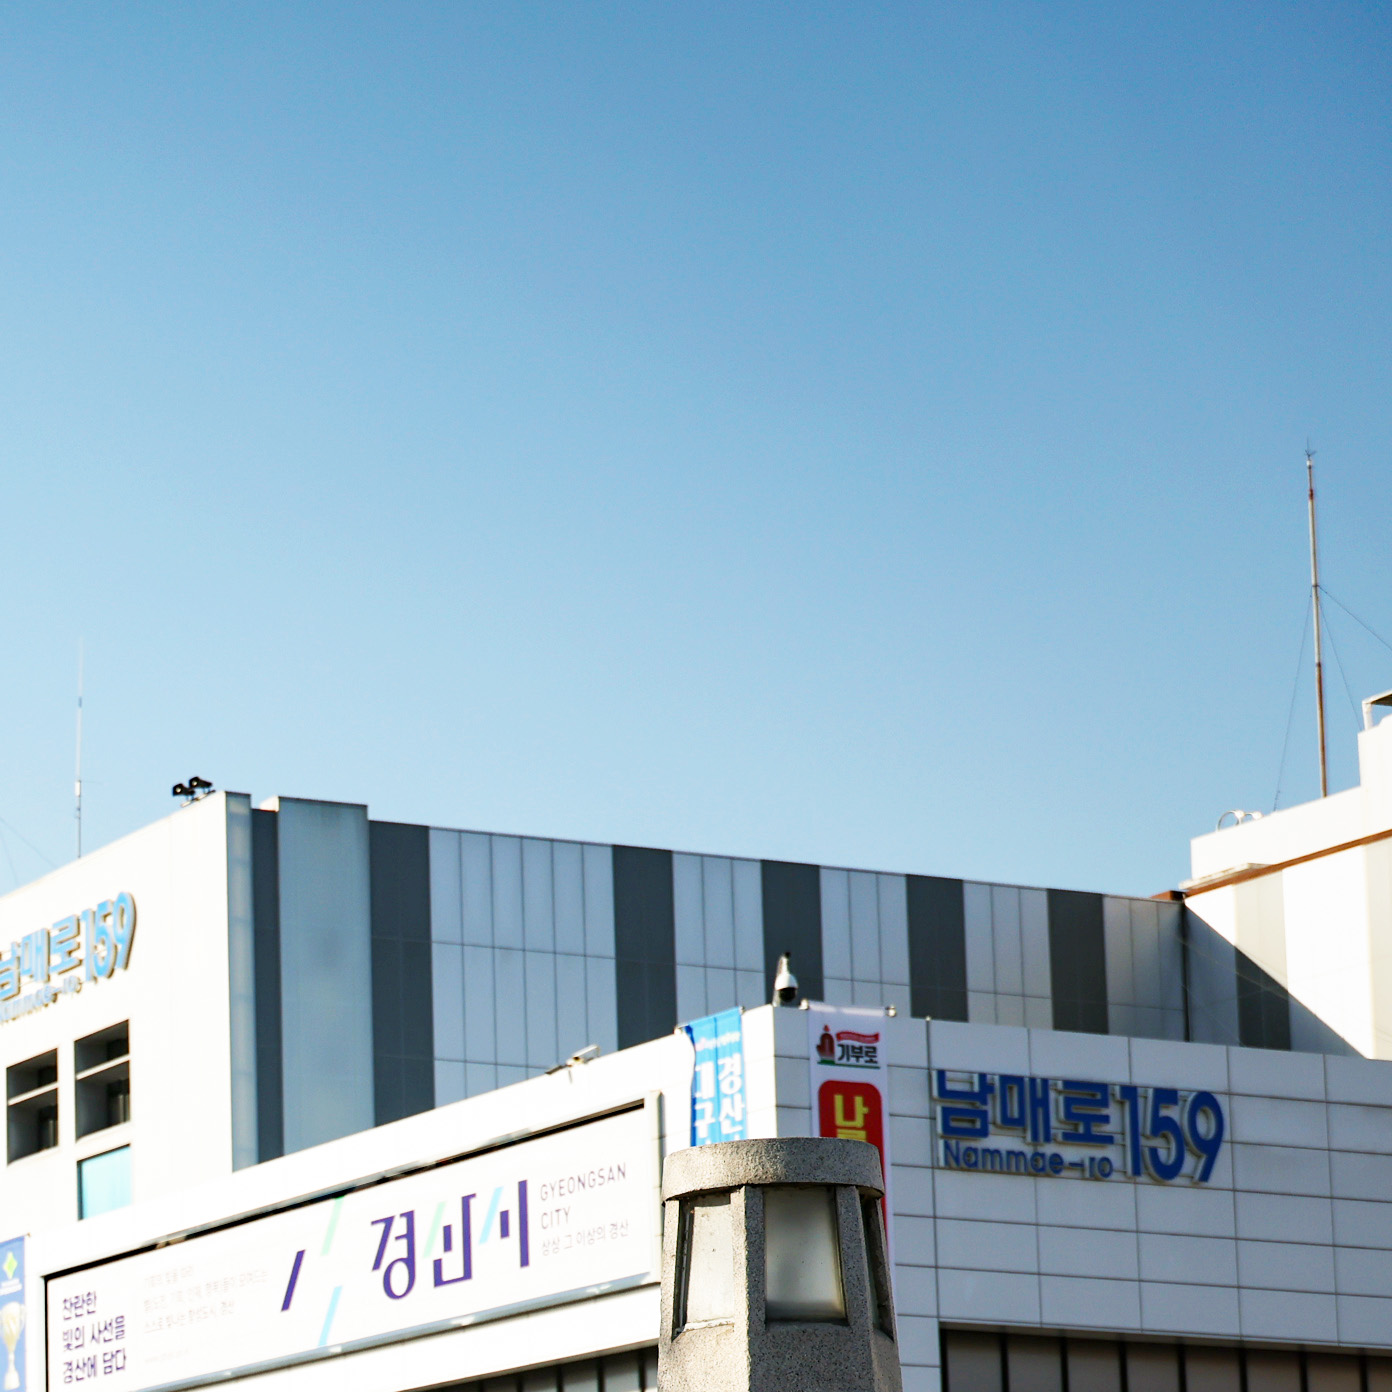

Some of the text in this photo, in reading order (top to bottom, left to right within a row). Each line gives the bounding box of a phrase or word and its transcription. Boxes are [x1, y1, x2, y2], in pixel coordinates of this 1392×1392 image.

[838, 1043, 879, 1065] 기부로
[940, 1138, 1115, 1180] Nammae-ro
[540, 1162, 628, 1201] GYEONGSAN
[540, 1206, 572, 1230] CITY
[370, 1179, 531, 1300] 경산시
[541, 1219, 630, 1257] 상상 그 이상의 경산
[62, 1291, 97, 1321] 찬란한
[62, 1355, 98, 1385] 경산에
[102, 1348, 127, 1376] 담다
